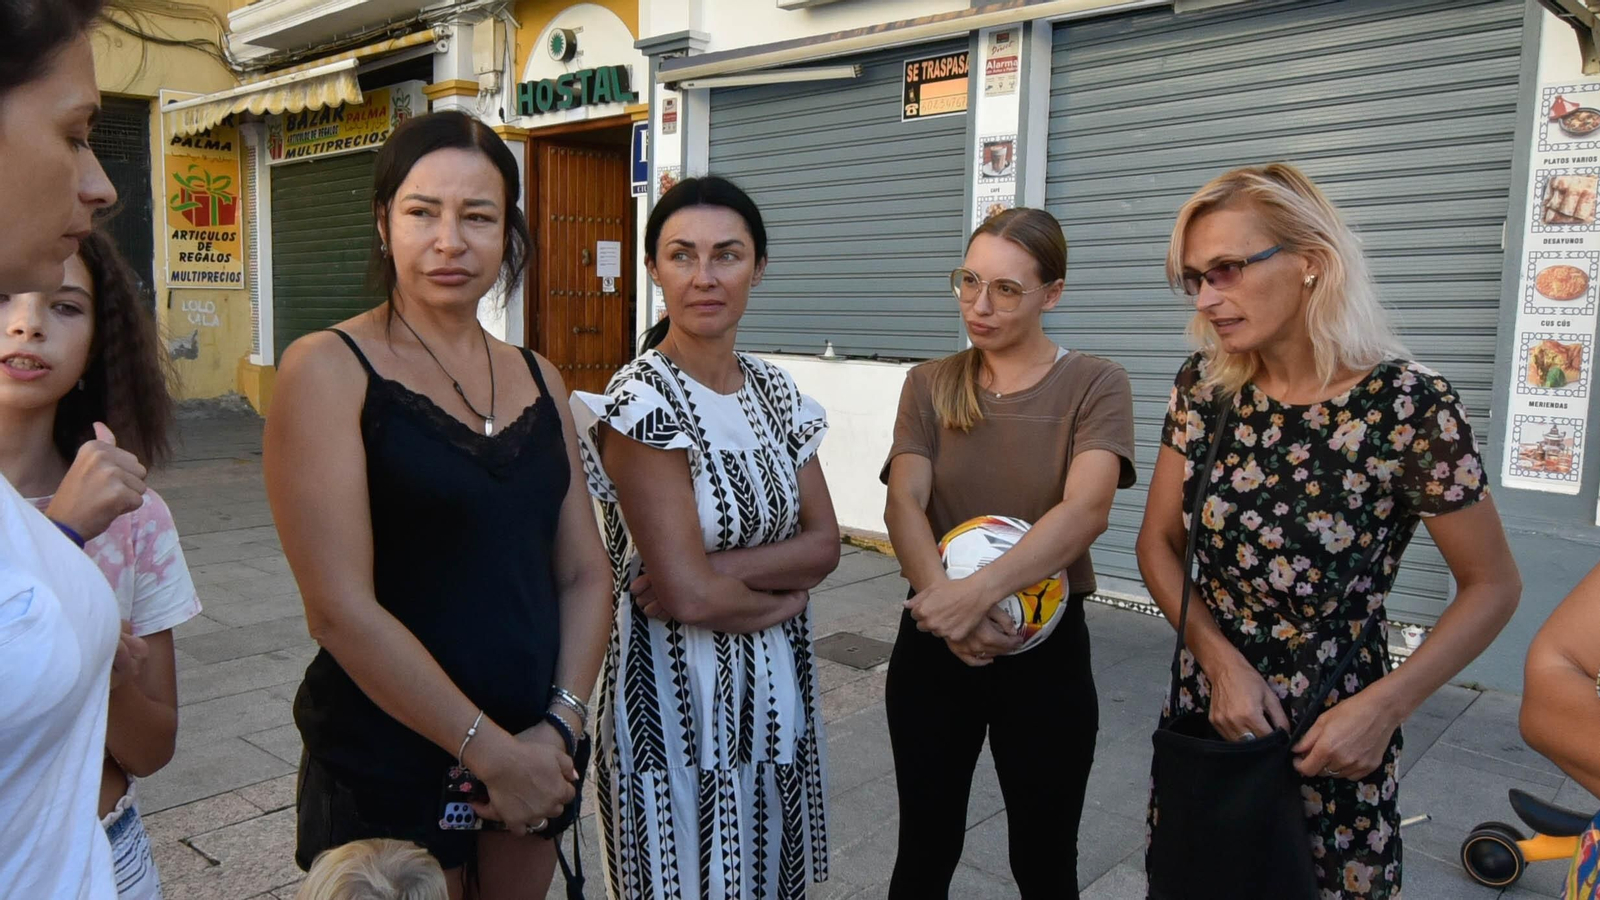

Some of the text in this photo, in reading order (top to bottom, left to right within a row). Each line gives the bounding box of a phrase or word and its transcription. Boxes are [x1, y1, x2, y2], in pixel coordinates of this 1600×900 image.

[986, 58, 1018, 70] Alarma
[906, 63, 920, 83] SE
[517, 65, 636, 115] HOSTAL
[286, 99, 346, 131] BAZAR
[346, 104, 387, 124] PALMA
[170, 136, 232, 151] PALMA
[285, 130, 389, 159] MULTIPRECIOS
[172, 230, 237, 241] ARTICULOS
[197, 242, 213, 252] DE
[179, 252, 232, 263] REGALOS
[171, 271, 242, 283] MULTIPRECIOS
[182, 300, 216, 314] LOLO
[1557, 319, 1571, 327] CÚS
[1529, 401, 1568, 409] MERIENDAS
